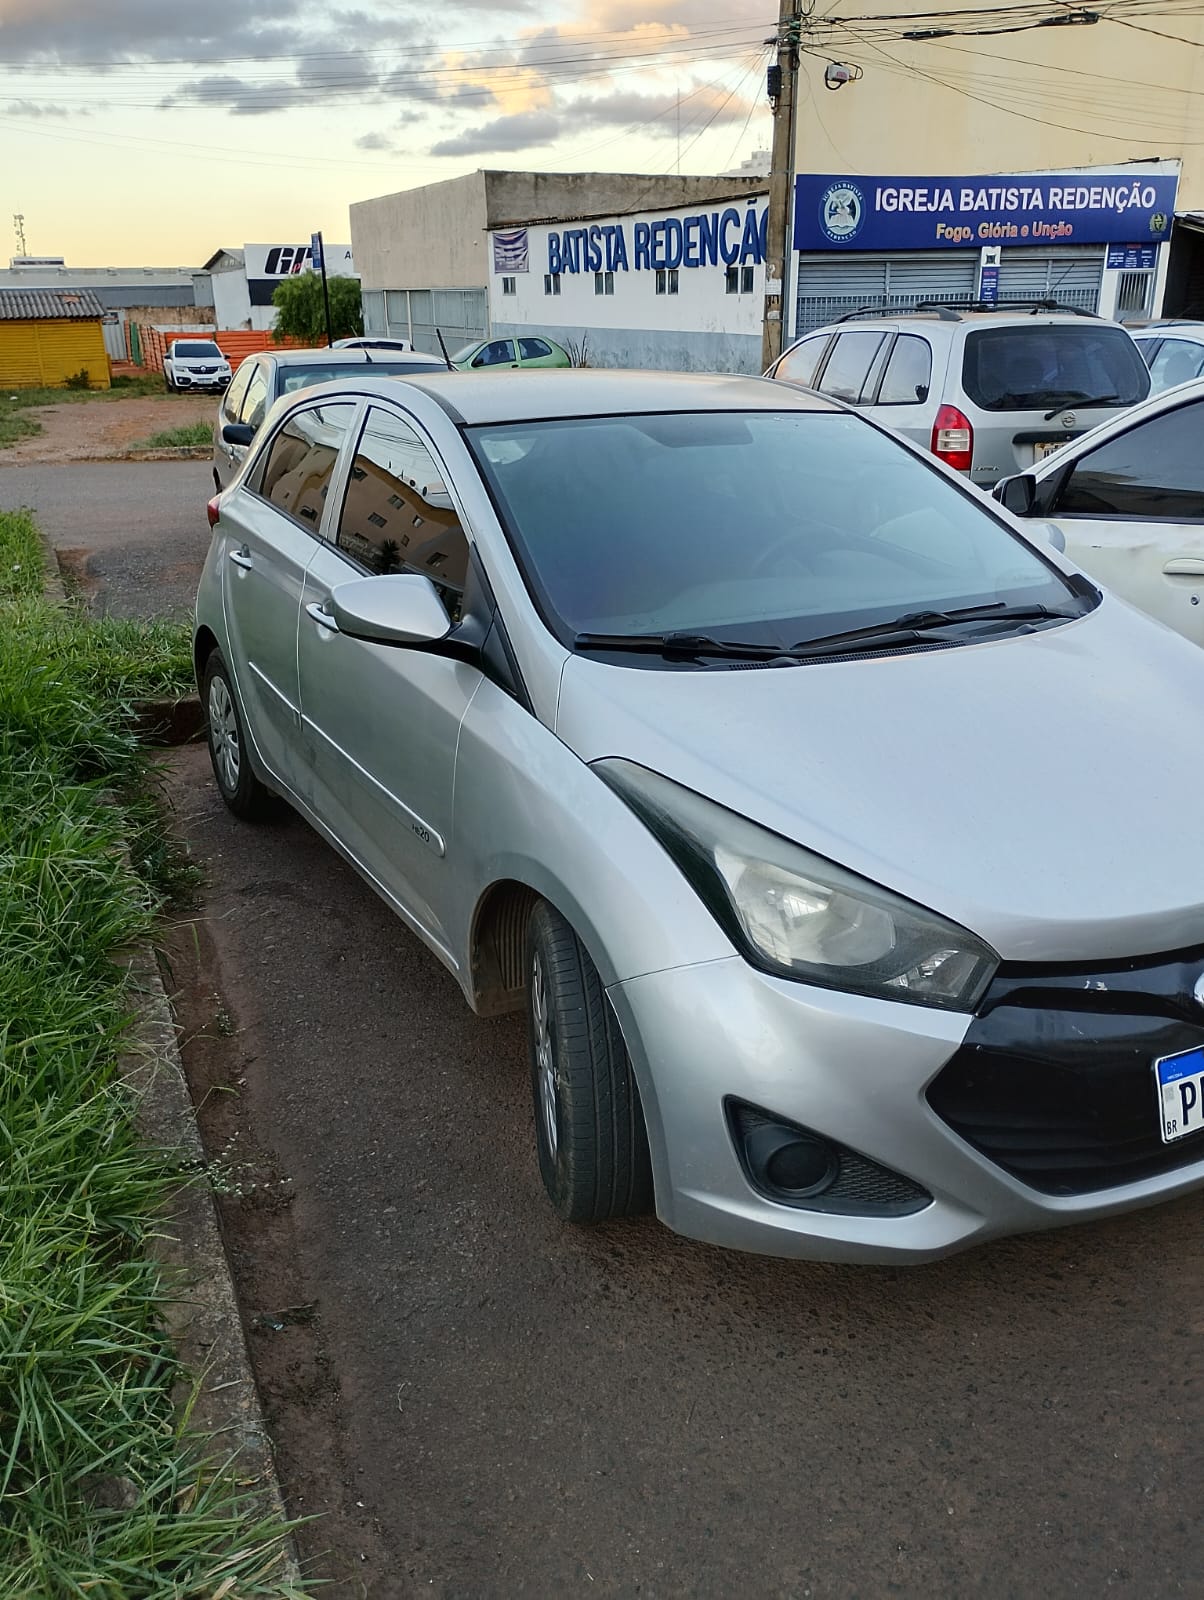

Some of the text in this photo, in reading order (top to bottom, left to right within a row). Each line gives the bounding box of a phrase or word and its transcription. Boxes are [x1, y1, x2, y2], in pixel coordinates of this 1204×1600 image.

[875, 182, 1156, 213] IGREJA BATISTA REDENÇÃO
[936, 221, 1073, 243] Fogo, Glória e Unção
[547, 225, 629, 275] BATISTA
[1179, 1076, 1204, 1126] P
[1166, 1119, 1178, 1135] BR
